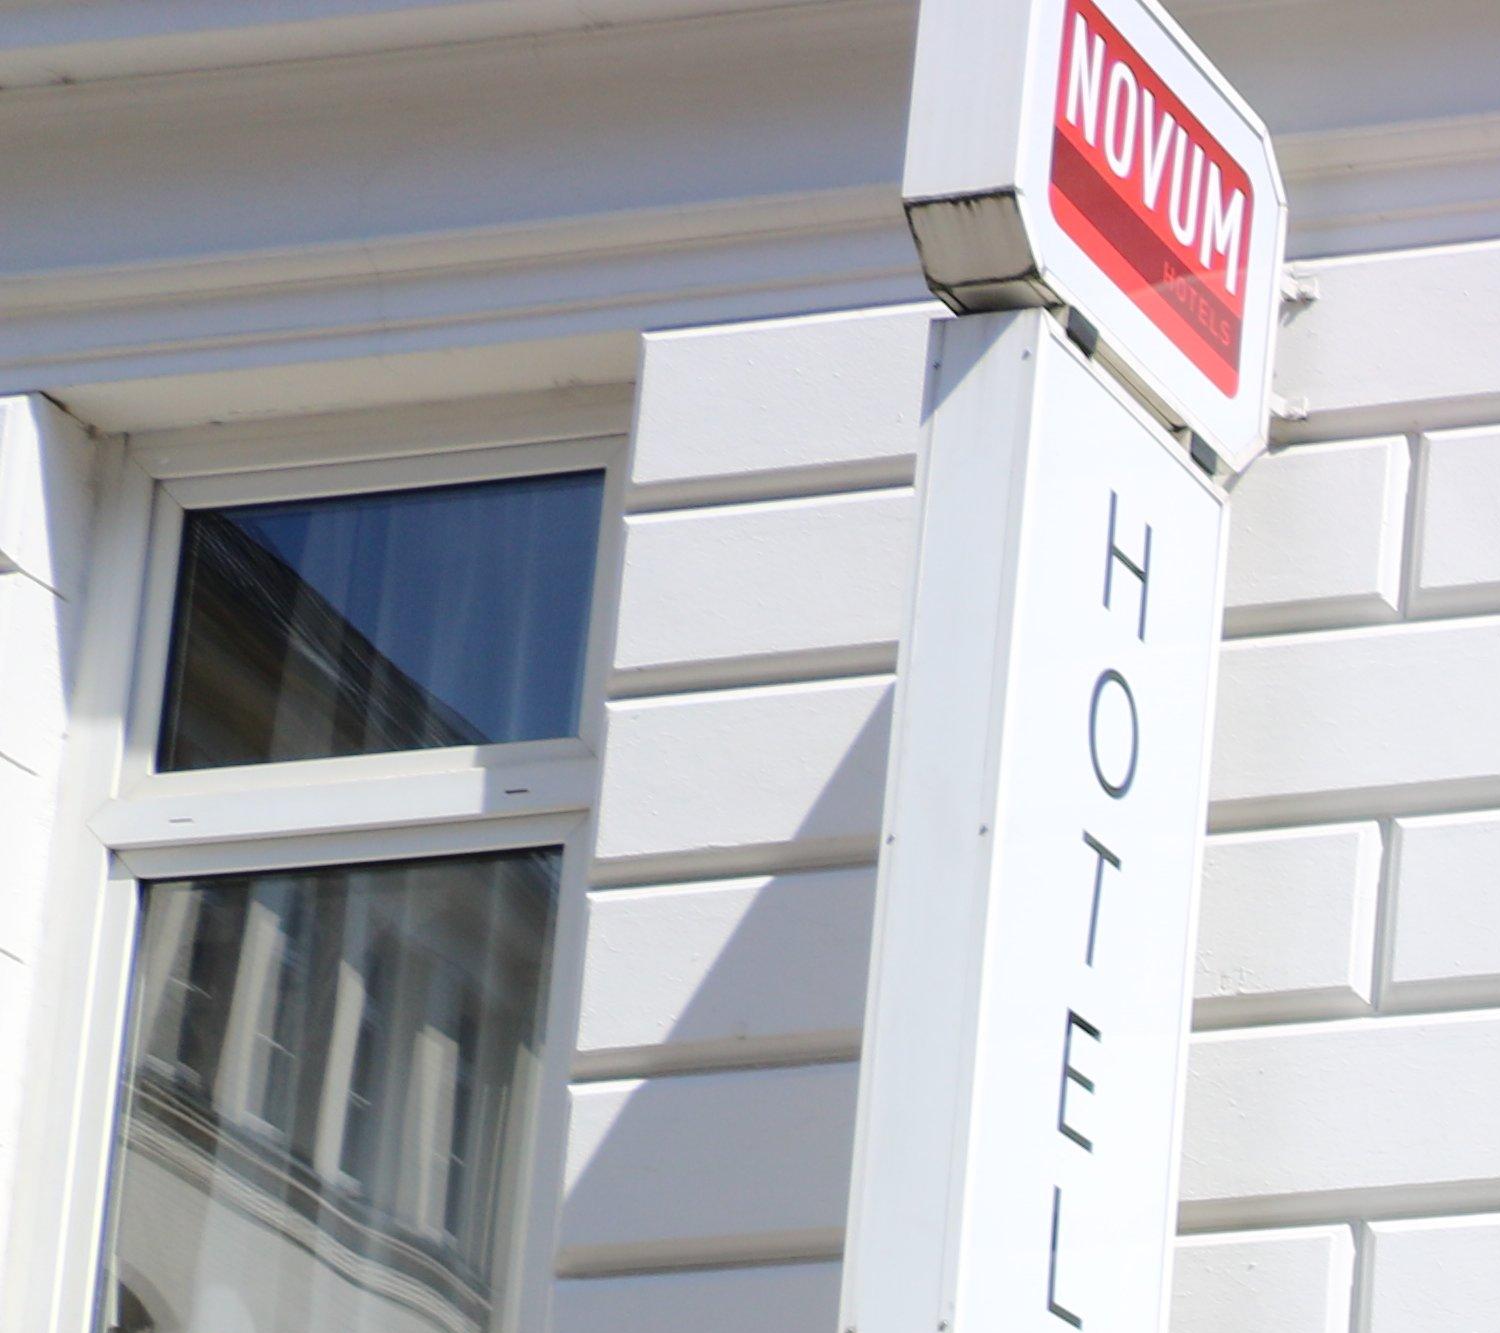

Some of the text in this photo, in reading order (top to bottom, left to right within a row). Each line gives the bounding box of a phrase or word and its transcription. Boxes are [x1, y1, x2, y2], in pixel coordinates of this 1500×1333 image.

[1065, 11, 1246, 297] NOVUM
[1162, 261, 1232, 348] HOTELS
[1046, 488, 1152, 1331] HOTEL
